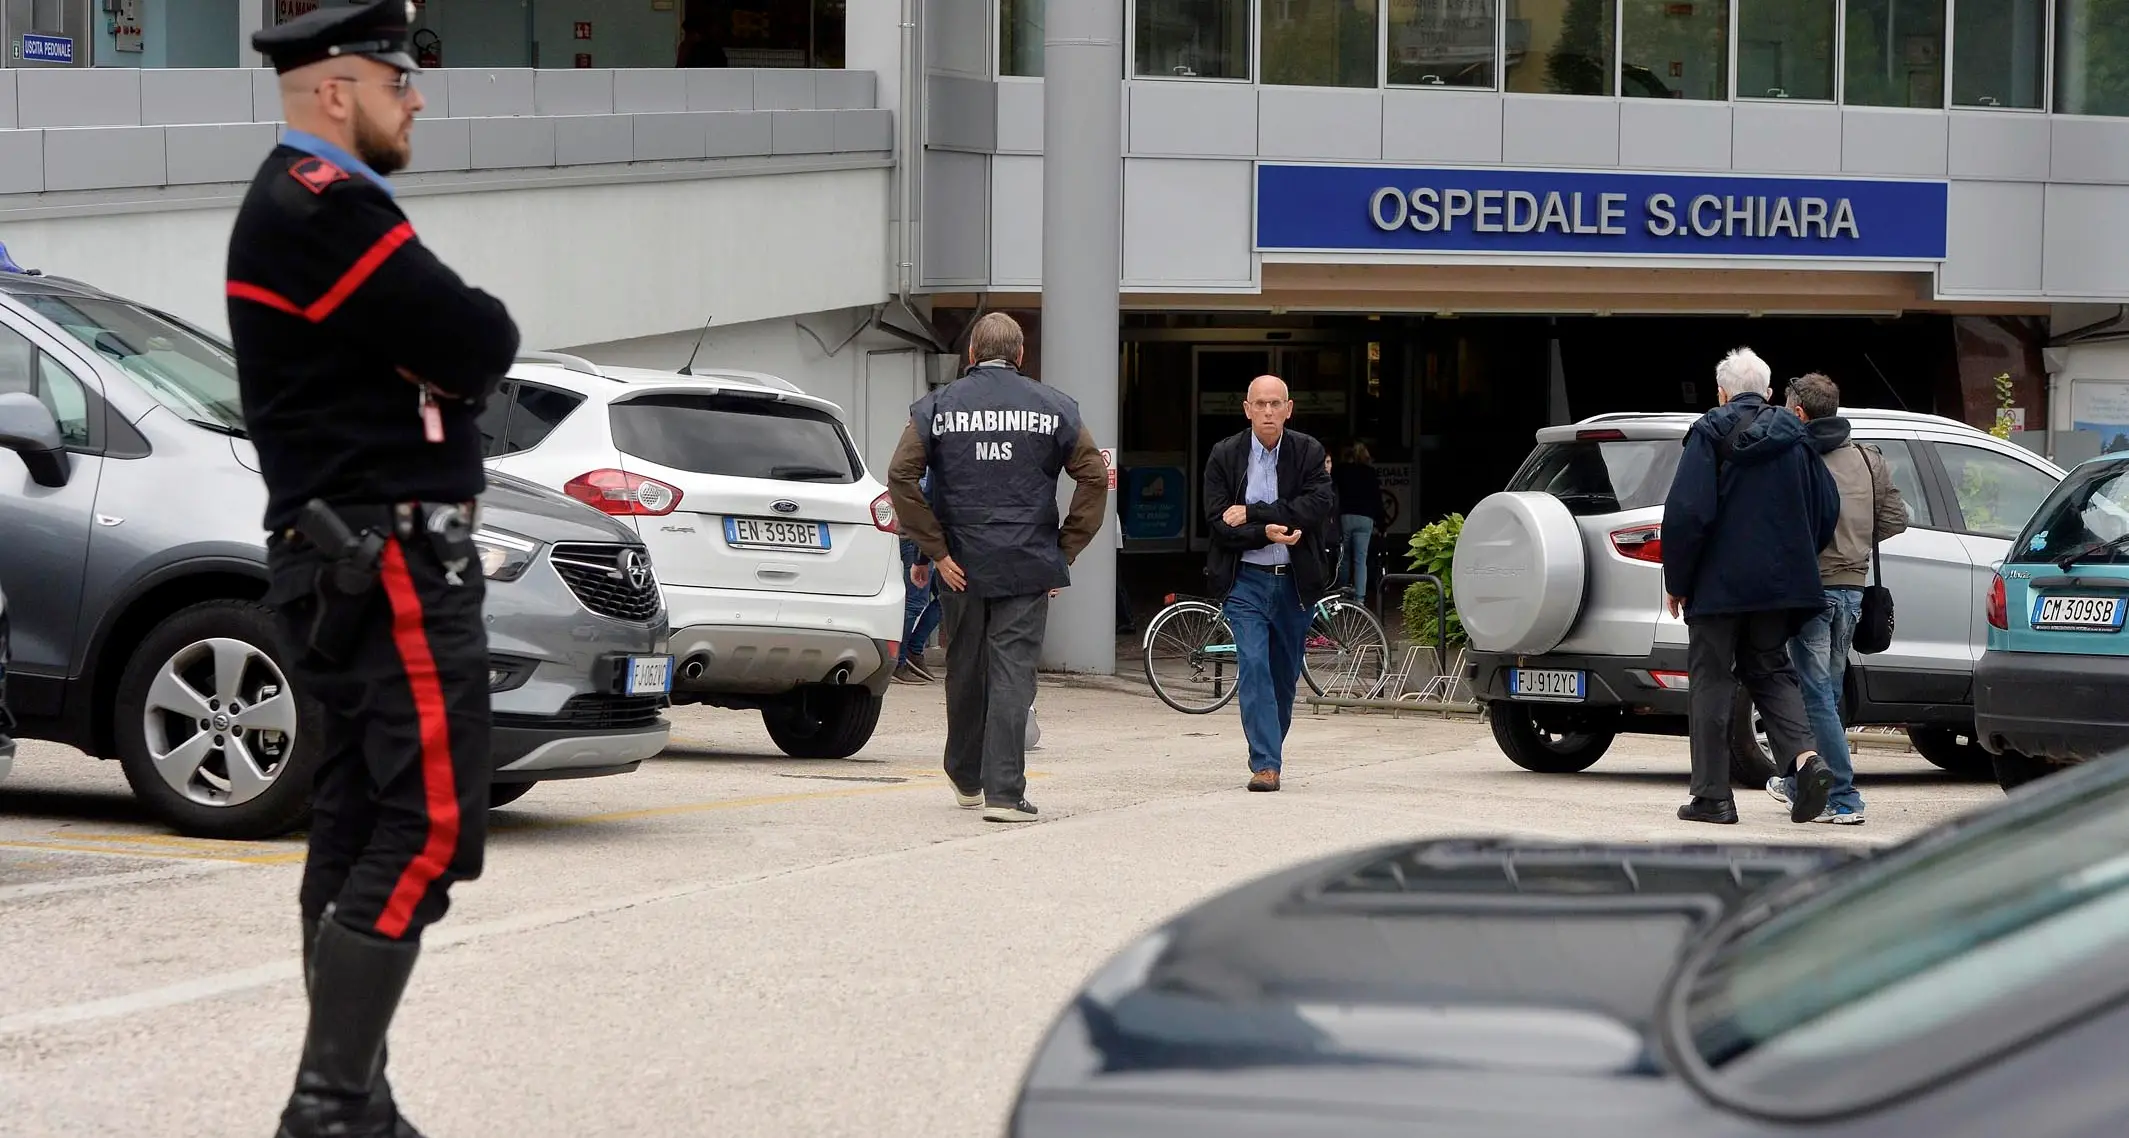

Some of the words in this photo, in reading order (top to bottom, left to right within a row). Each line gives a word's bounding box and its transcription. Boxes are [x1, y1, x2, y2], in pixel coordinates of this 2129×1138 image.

[24, 40, 43, 55] USCITA
[44, 42, 71, 58] PEDONALE
[1369, 186, 1627, 235] OSPEDALE
[1647, 193, 1860, 239] S.CHIARA
[932, 410, 1060, 436] CARABINIERI
[975, 441, 1013, 461] NAS
[737, 520, 763, 541] EN
[766, 522, 816, 544] 393BF
[2042, 599, 2063, 621] CM
[2064, 600, 2114, 622] 309SB
[1518, 672, 1533, 692] FJ
[1538, 673, 1576, 693] 912YC
